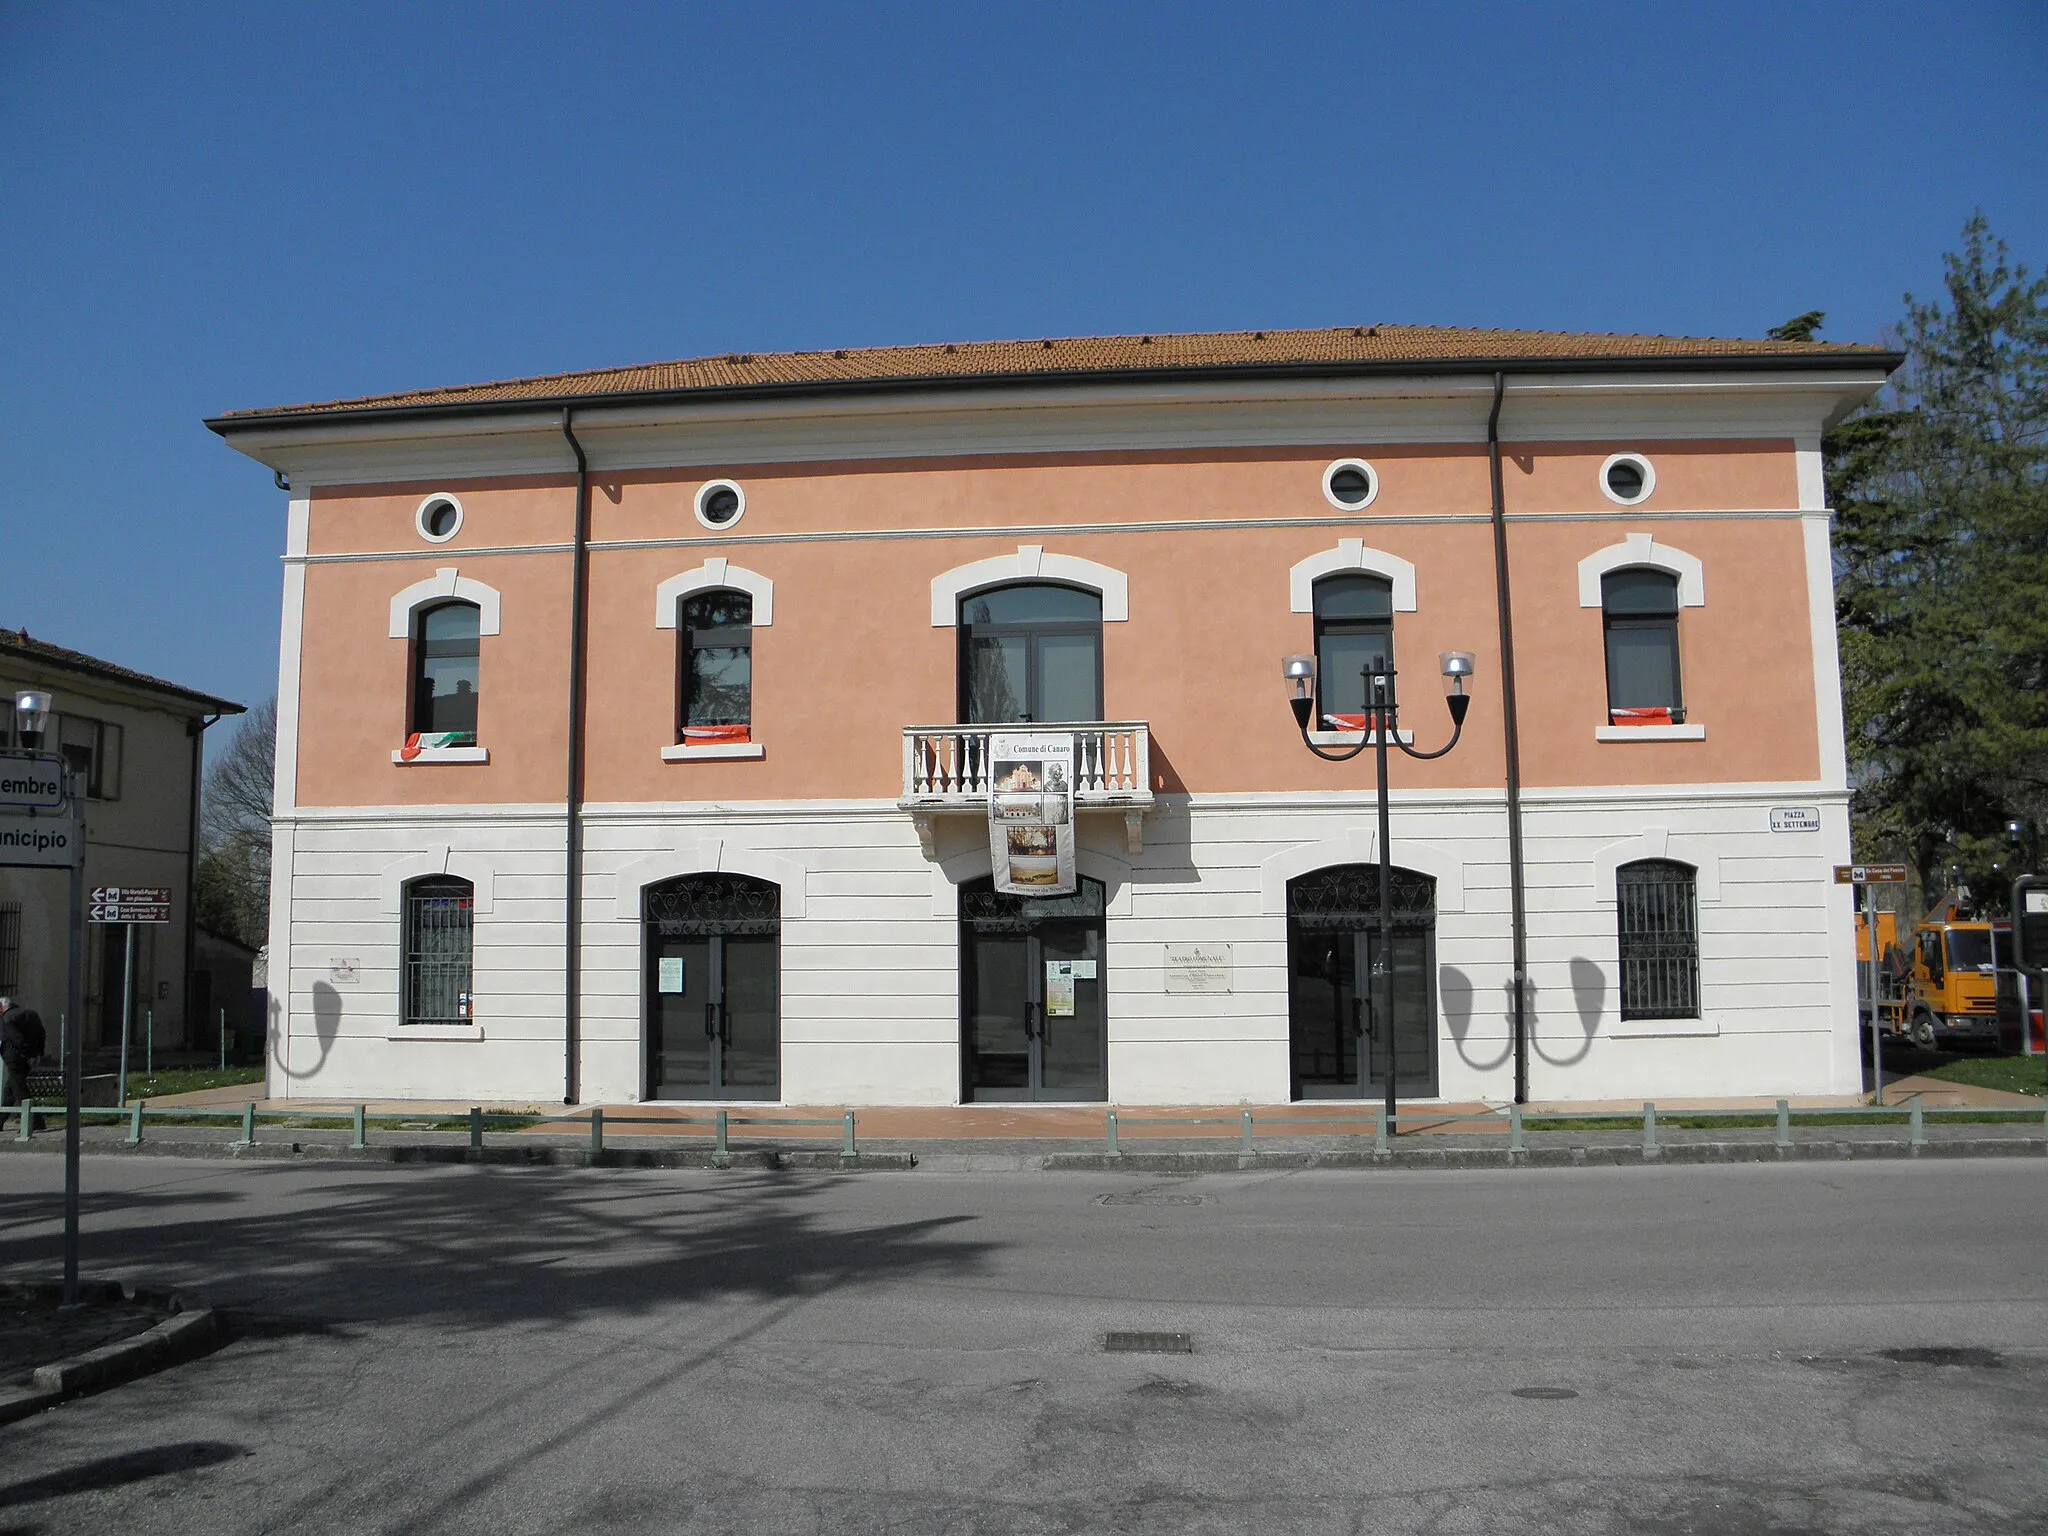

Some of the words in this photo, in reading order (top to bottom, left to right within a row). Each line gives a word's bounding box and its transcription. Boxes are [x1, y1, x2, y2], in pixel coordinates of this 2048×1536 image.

[1013, 744, 1039, 753] Comune
[1039, 744, 1047, 753] di
[1047, 744, 1071, 753] Canaro
[0, 776, 57, 795] embre
[1783, 820, 1819, 829] SETTEMBRE
[0, 829, 67, 852] nicipio
